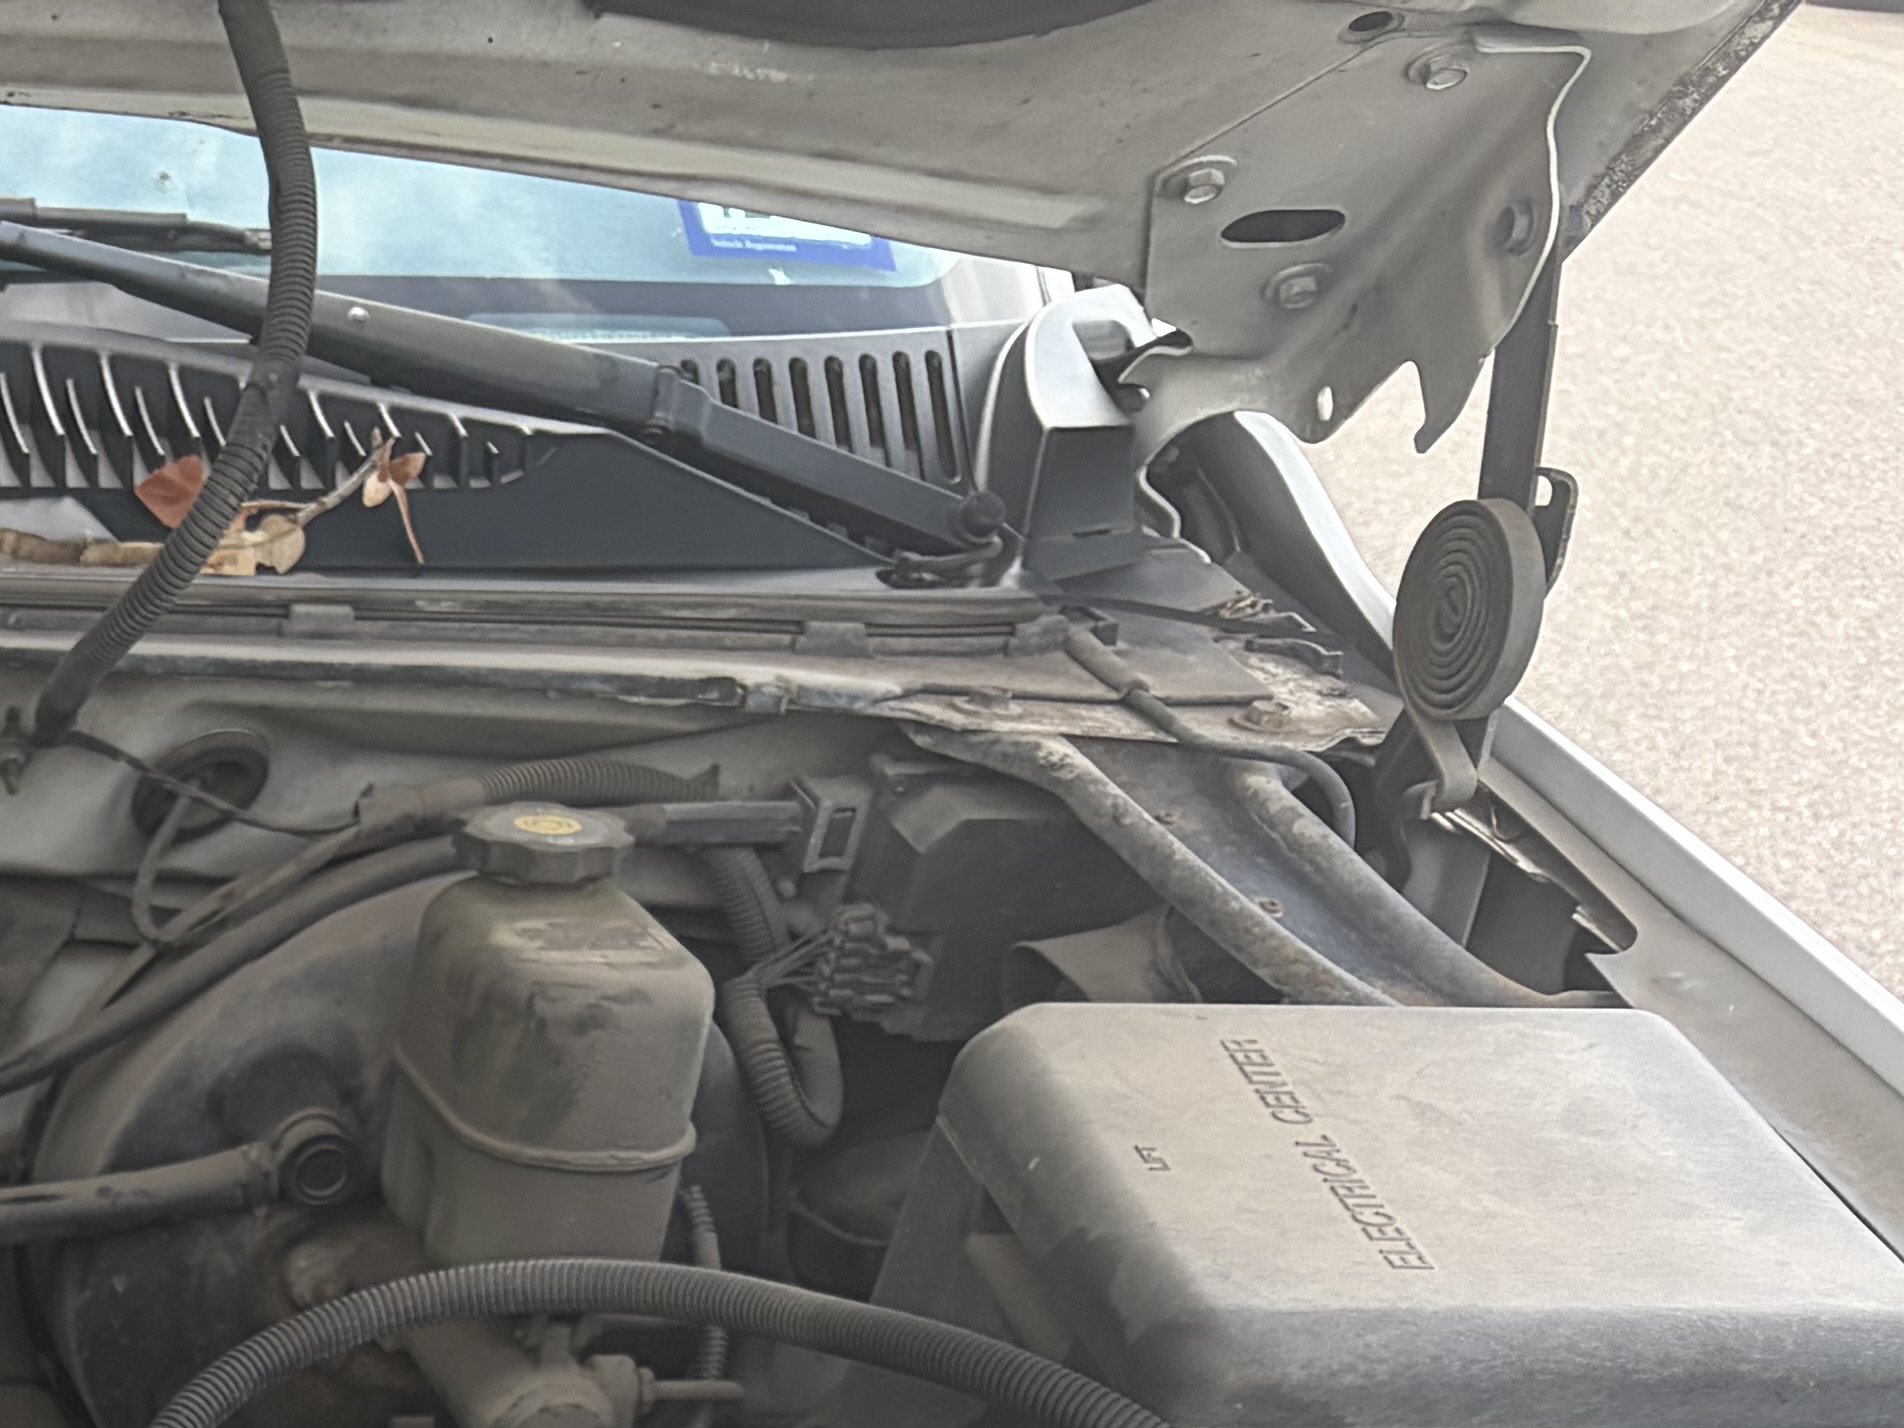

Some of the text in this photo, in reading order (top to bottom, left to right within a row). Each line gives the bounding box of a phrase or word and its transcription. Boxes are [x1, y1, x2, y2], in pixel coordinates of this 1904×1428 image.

[1133, 1144, 1171, 1171] LIFT
[1220, 1038, 1435, 1269] ELECTRICAL CENTER
